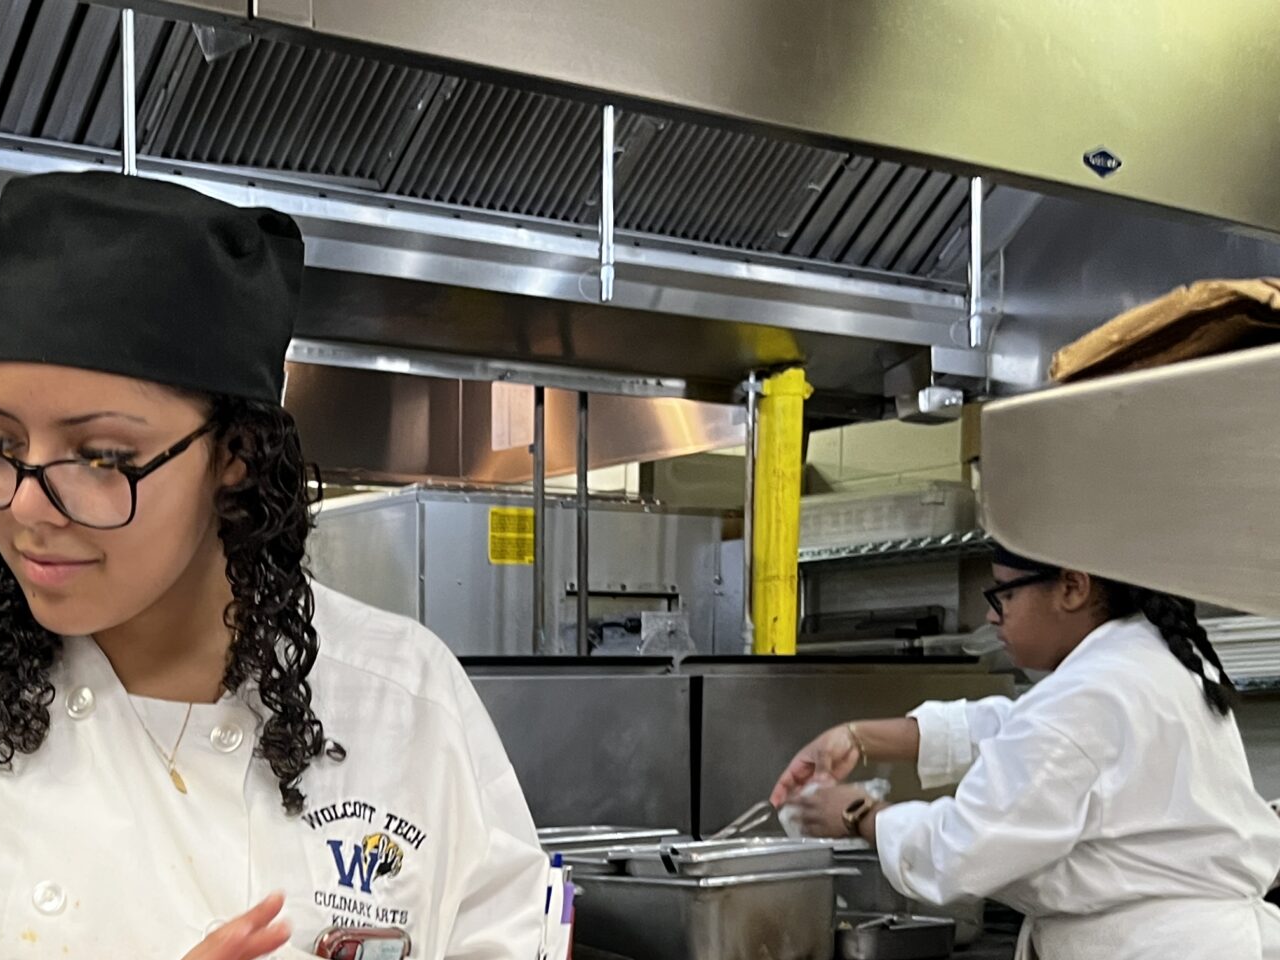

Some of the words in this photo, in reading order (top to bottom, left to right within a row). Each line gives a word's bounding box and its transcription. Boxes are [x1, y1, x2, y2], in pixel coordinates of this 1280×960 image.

[302, 801, 376, 830] WOLCOTT
[384, 813, 427, 850] TECH
[326, 840, 379, 894] W
[314, 891, 372, 918] CULINARY
[376, 904, 408, 924] ARTS
